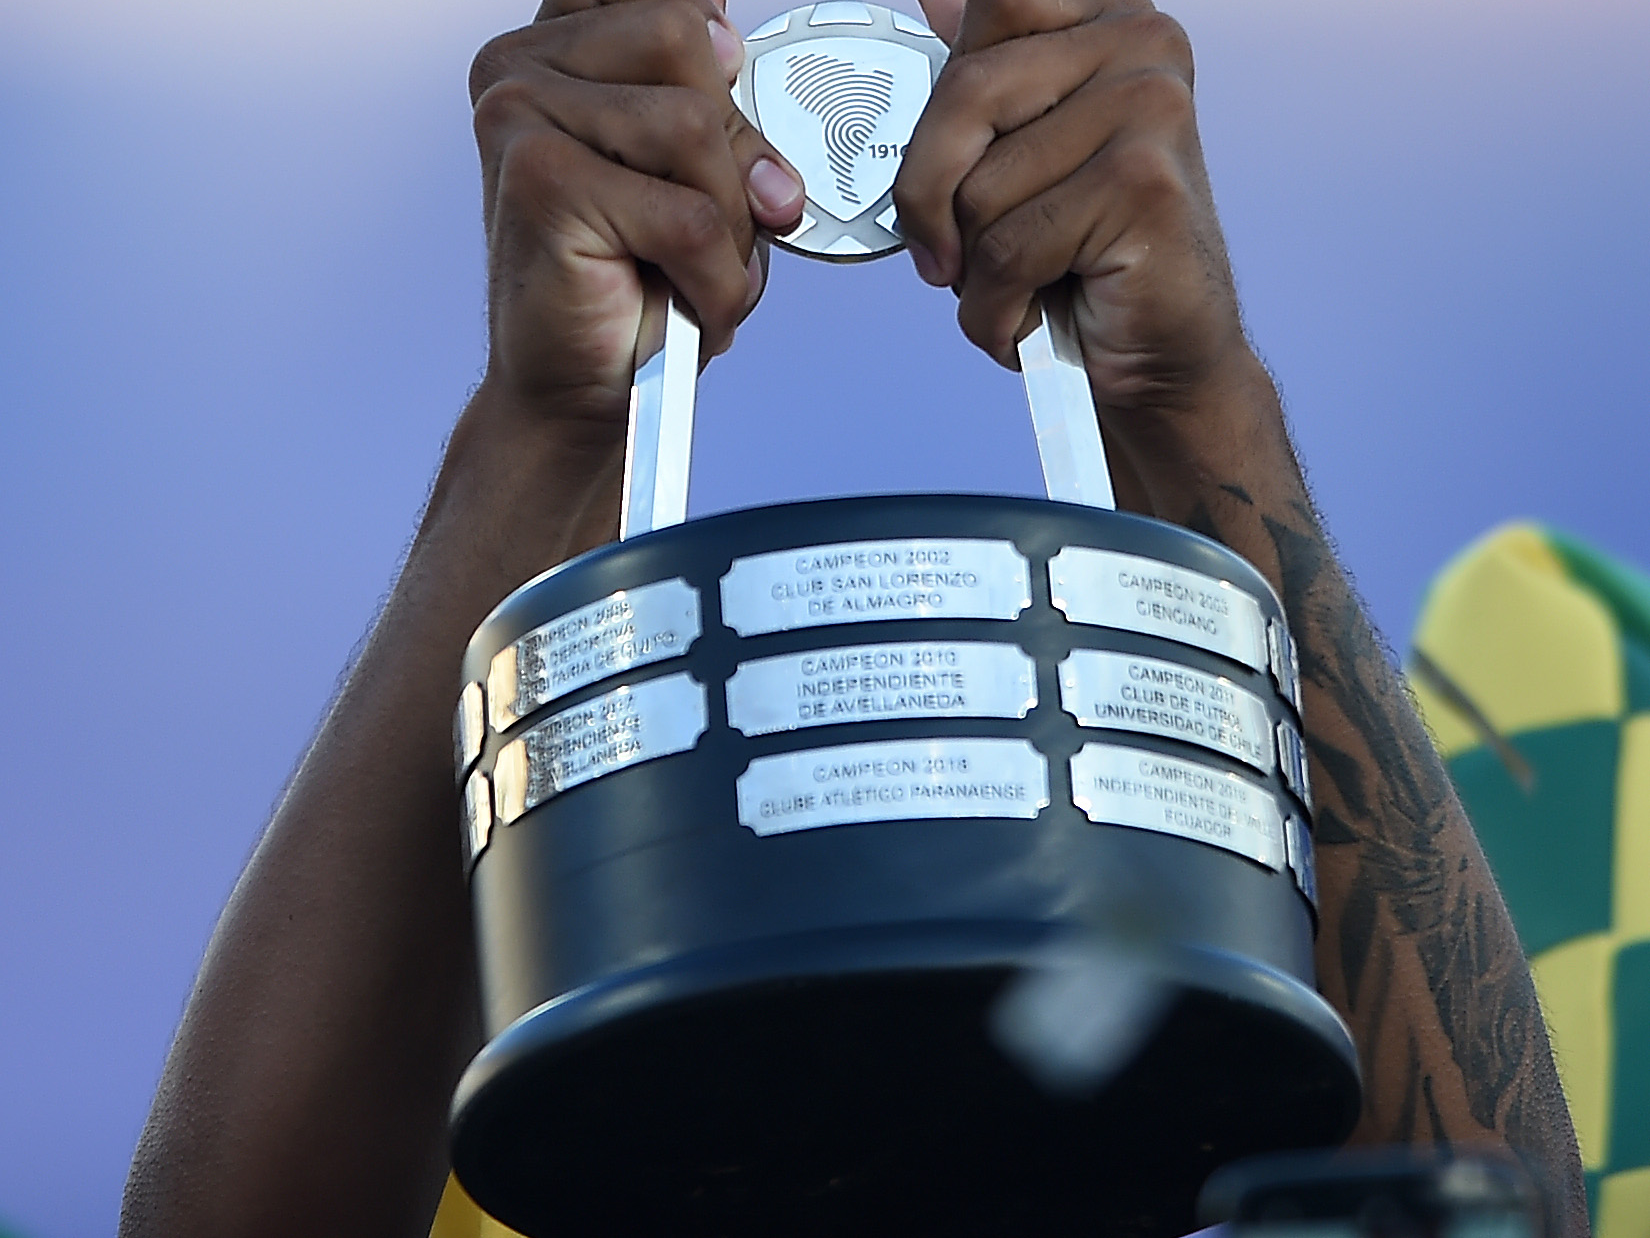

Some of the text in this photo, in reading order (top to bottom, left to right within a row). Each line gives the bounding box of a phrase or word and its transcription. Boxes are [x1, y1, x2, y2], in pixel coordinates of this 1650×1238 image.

[794, 552, 898, 575] CAMPEON
[771, 572, 978, 601] CLUB SAN LORENZO
[1118, 571, 1194, 603] CAMPEON
[807, 593, 943, 616] DE ALMAGRO
[1135, 599, 1217, 635] CIENCIANO
[799, 652, 904, 676] CAMPEON
[796, 672, 965, 697] INDEPENDIENTE
[1128, 664, 1205, 696] CAMPEON
[798, 693, 966, 720] DE AVELLANEDA
[1120, 684, 1166, 704] CLUB
[1168, 695, 1190, 711] DE
[1094, 702, 1205, 738] UNIVERSIDAD
[1207, 728, 1228, 742] DE
[811, 762, 917, 784] CAMPEON
[1138, 760, 1216, 794] CAMPEON
